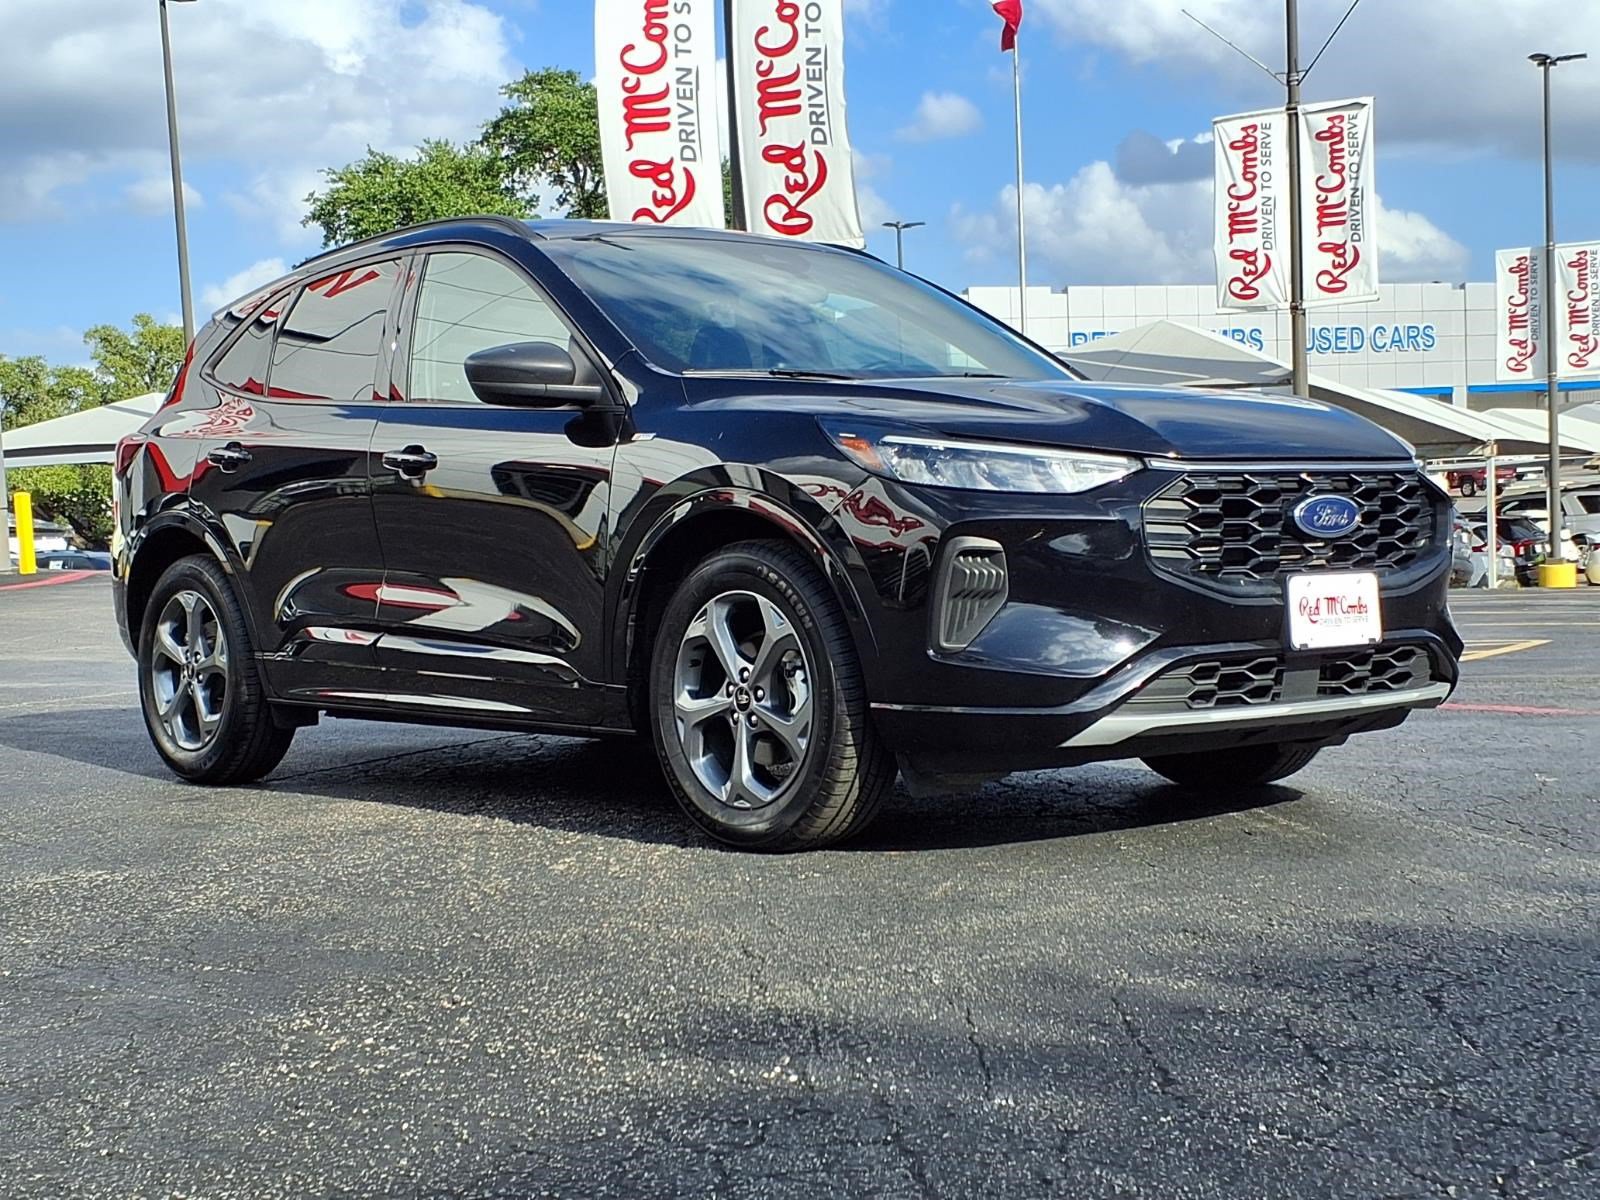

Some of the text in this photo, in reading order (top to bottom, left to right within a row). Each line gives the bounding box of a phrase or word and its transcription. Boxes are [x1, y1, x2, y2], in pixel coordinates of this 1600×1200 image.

[619, 0, 671, 151] McCom
[673, 0, 697, 162] DRIVEN TO S
[754, 0, 827, 236] Red McCo
[804, 2, 827, 145] DRIVEN TO
[1227, 123, 1258, 244] McCombs
[1260, 122, 1273, 250] DRIVEN TO SERVE
[1315, 114, 1360, 293] Red McCombs
[1347, 113, 1361, 243] DRIVEN TO SERVE
[1228, 248, 1272, 300] Red
[1506, 256, 1537, 372] Red McCombs
[1529, 255, 1538, 341] DRIVEN TO SERVE
[1567, 250, 1598, 368] Red McCombs
[1590, 249, 1600, 335] DRIVEN TO SERVE
[1371, 325, 1436, 351] CARS
[1313, 503, 1349, 527] Ford
[1299, 596, 1320, 624] Red
